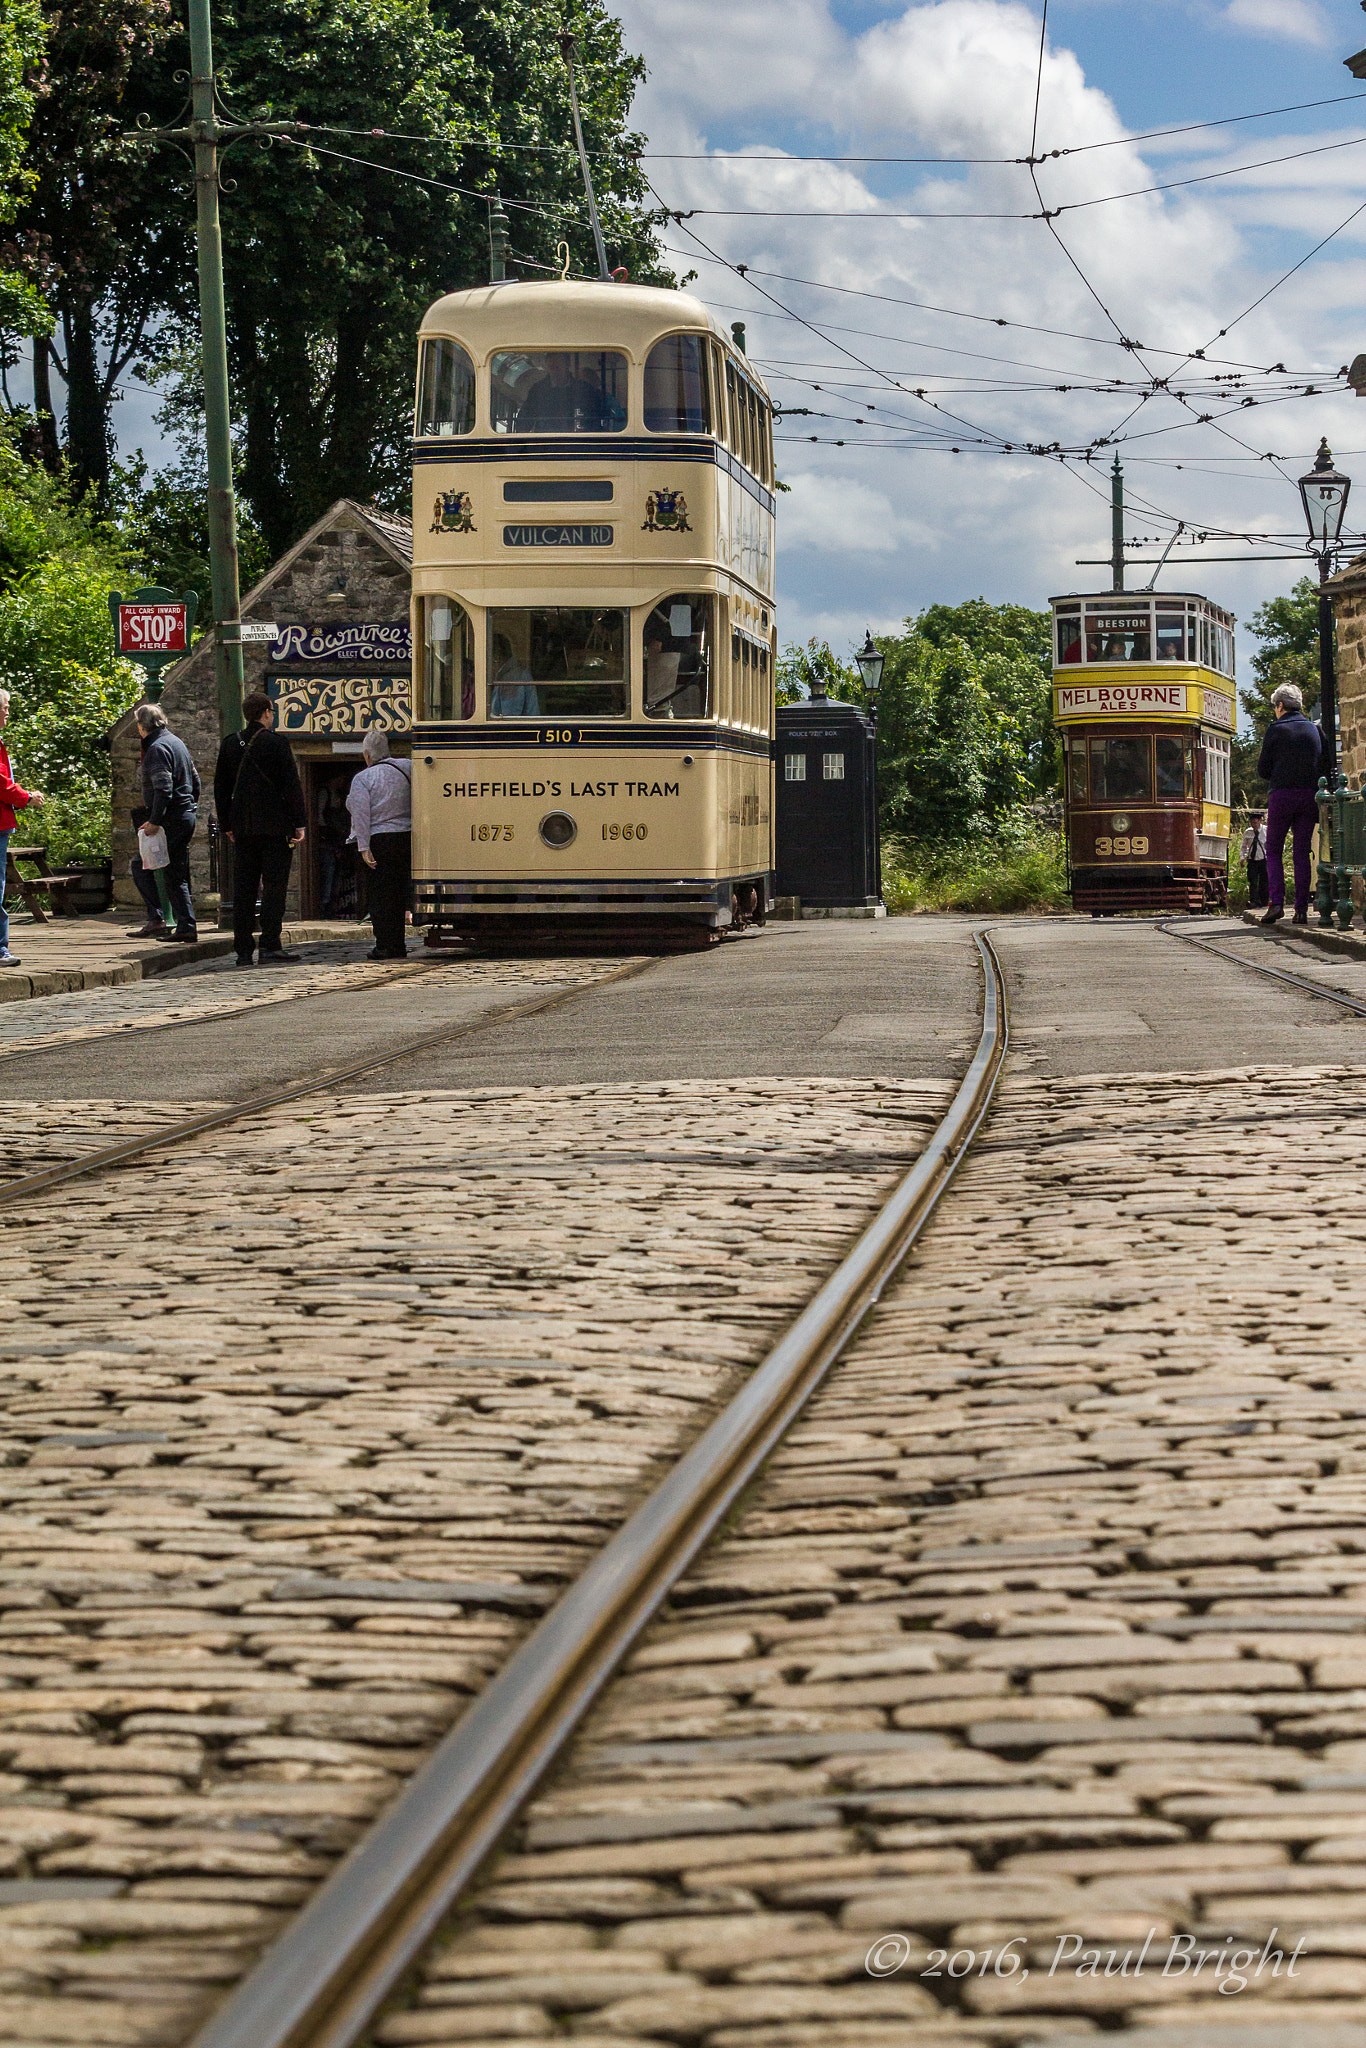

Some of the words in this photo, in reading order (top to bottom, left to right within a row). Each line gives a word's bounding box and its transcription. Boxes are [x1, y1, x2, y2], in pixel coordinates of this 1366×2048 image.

[508, 527, 584, 545] VULCAN
[591, 526, 612, 544] RD
[130, 615, 176, 642] STOP
[1097, 619, 1147, 629] BEESTON
[338, 650, 358, 658] ELECT
[275, 678, 307, 696] The
[1062, 687, 1181, 709] MELBOURNE
[1100, 701, 1137, 711] ALES
[545, 730, 572, 743] 510
[443, 780, 562, 798] SHEFFIELD'S
[571, 782, 619, 797] LAST
[625, 782, 679, 797] TRAM
[471, 824, 515, 841] 1873
[602, 823, 648, 840] 1960
[1095, 836, 1149, 856] 399
